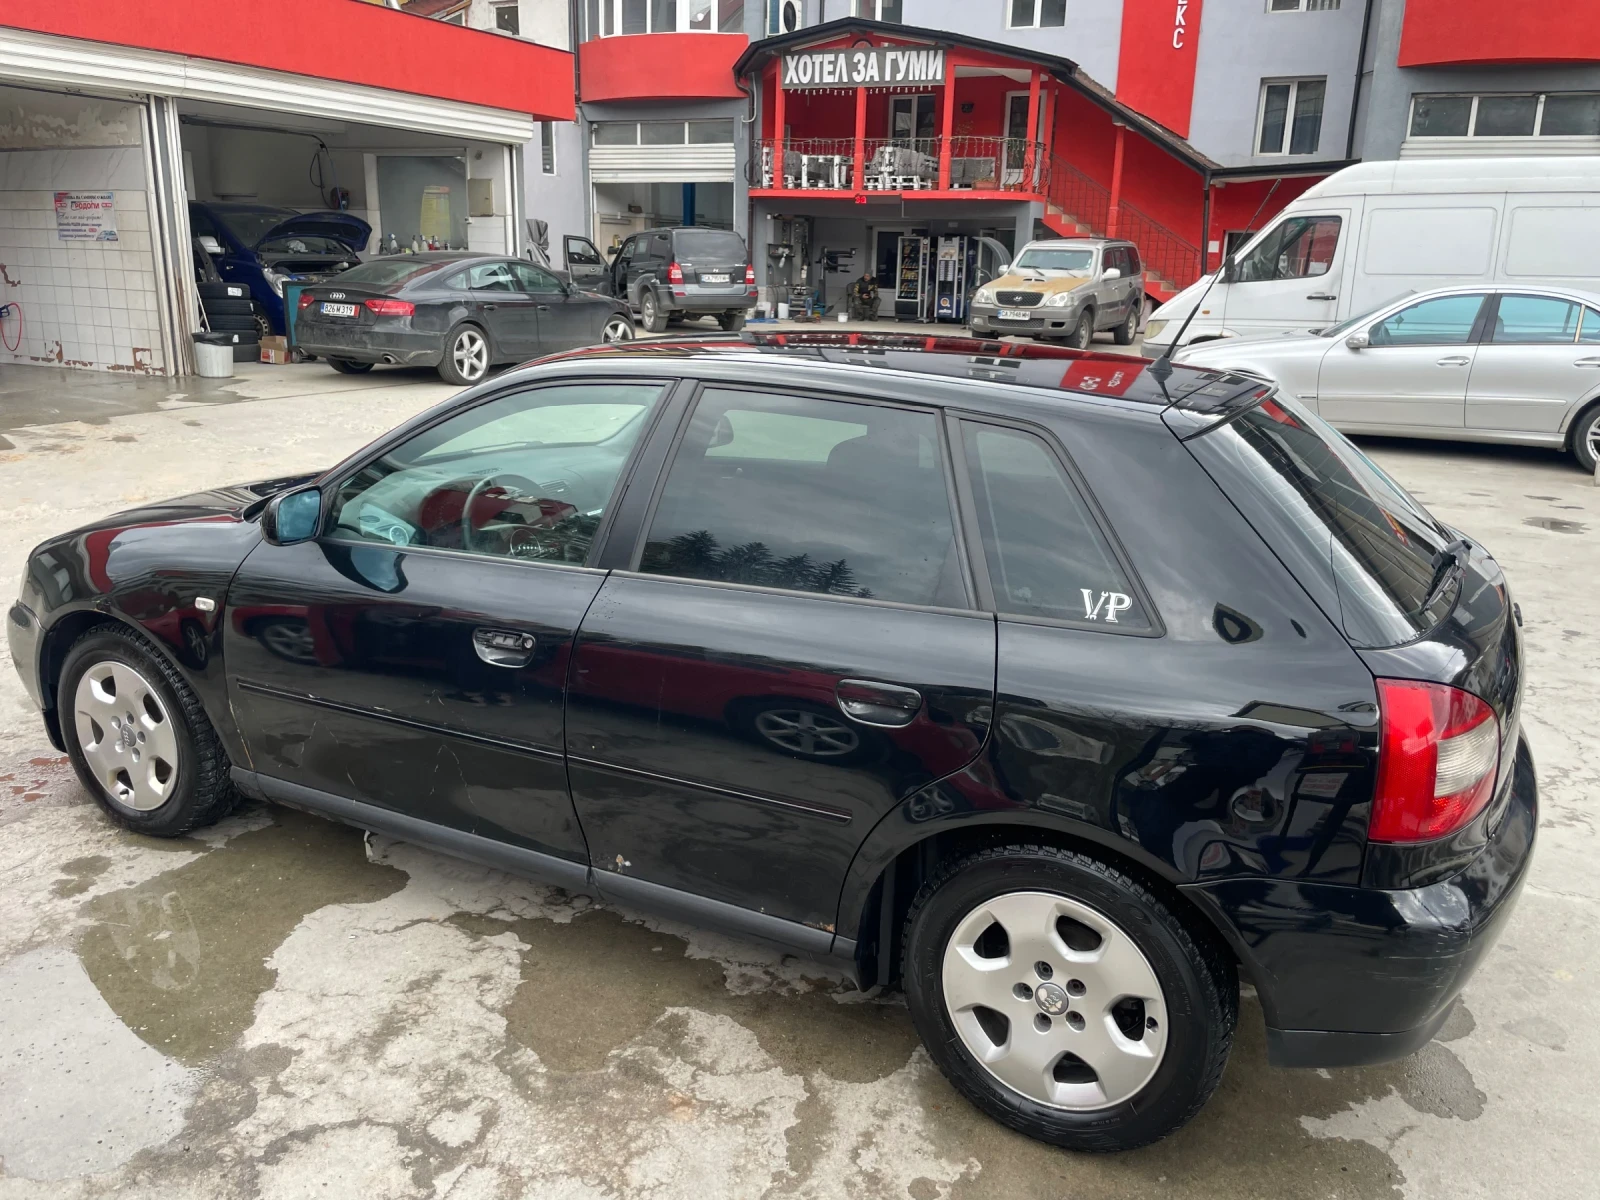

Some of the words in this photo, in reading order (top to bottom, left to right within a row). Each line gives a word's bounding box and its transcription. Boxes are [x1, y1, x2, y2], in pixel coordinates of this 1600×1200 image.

[1173, 0, 1188, 49] КС
[784, 53, 849, 84] ХОТЕЛ
[852, 52, 880, 82] ЗА
[884, 50, 943, 81] ГУМИ
[1080, 588, 1132, 623] VP
